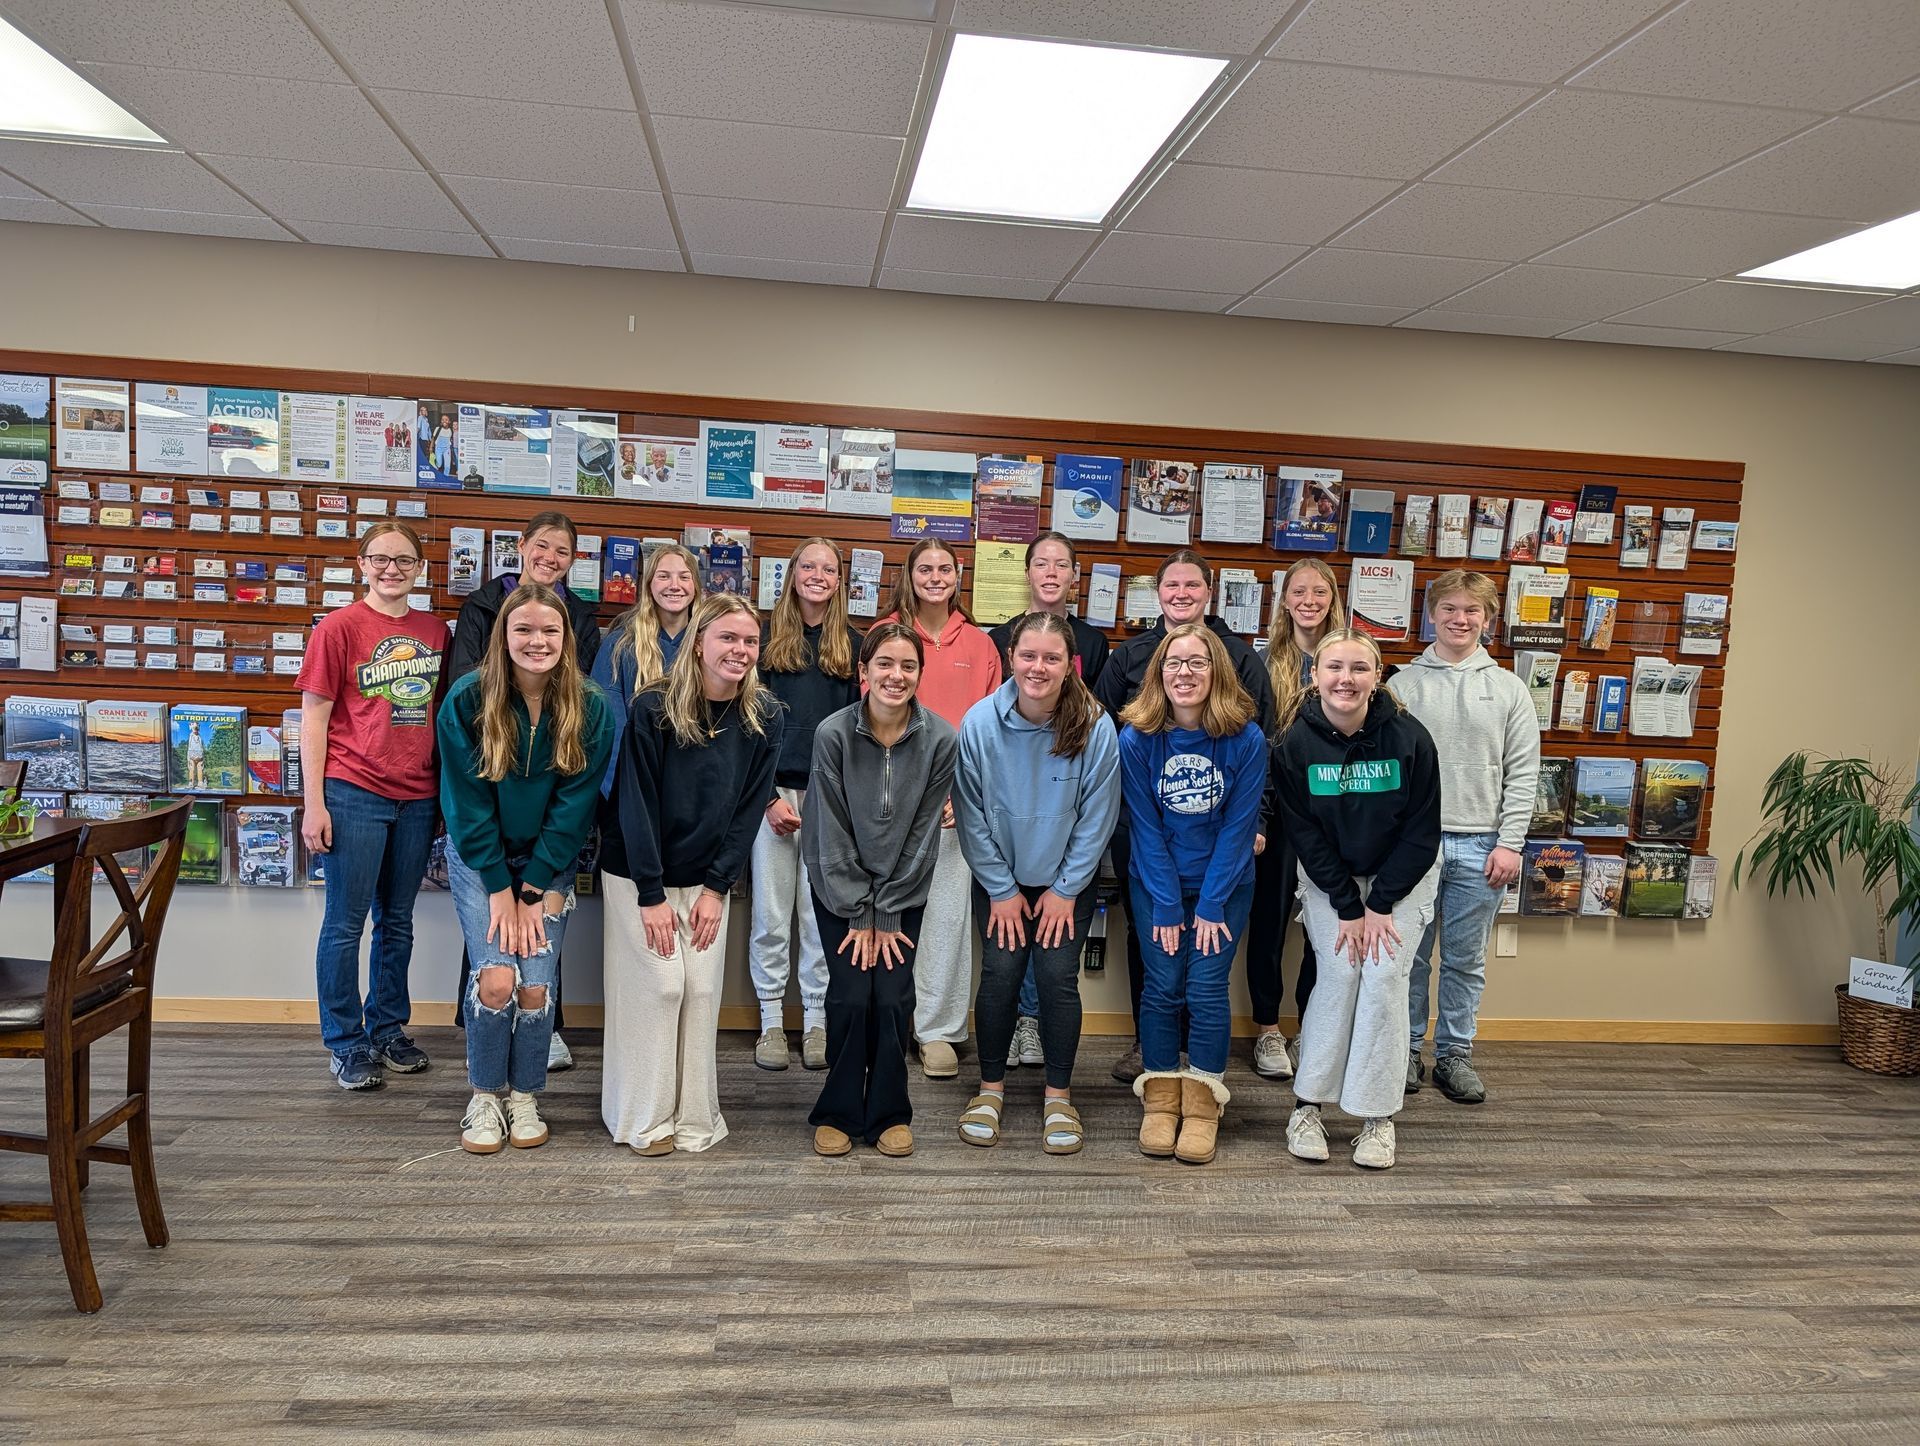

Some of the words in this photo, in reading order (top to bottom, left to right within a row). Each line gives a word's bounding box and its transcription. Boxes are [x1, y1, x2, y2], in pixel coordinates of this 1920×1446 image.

[211, 404, 276, 420] ACTION
[370, 412, 384, 420] ARE
[354, 418, 382, 427] HIRING
[988, 468, 1033, 476] CONCORDIA
[1080, 473, 1112, 481] MAGNIFI
[5, 503, 29, 512] mentally!
[899, 516, 917, 526] Parent
[897, 526, 923, 534] Aware
[1360, 566, 1394, 578] MCSI
[375, 641, 390, 659] TRAP
[390, 638, 432, 655] SHOOTING
[9, 703, 37, 711] COOK
[38, 705, 76, 715] COUNTY
[98, 709, 126, 717] CRANE
[128, 710, 148, 718] LAKE
[174, 714, 208, 722] DETROIT
[288, 752, 299, 762] TO
[1169, 757, 1202, 771] LAERS
[1538, 764, 1561, 773] sboro
[288, 763, 299, 791] WELCOME
[1157, 778, 1190, 795] Honor
[1190, 766, 1225, 788] Society
[1340, 778, 1371, 792] SPEECH
[72, 798, 124, 810] PIPESTONE
[1540, 845, 1577, 858] Willmar
[1640, 851, 1687, 859] WORTHINGTON
[1593, 860, 1623, 871] WINONA
[1864, 968, 1898, 981] Grow
[1853, 976, 1908, 995] Kindness
